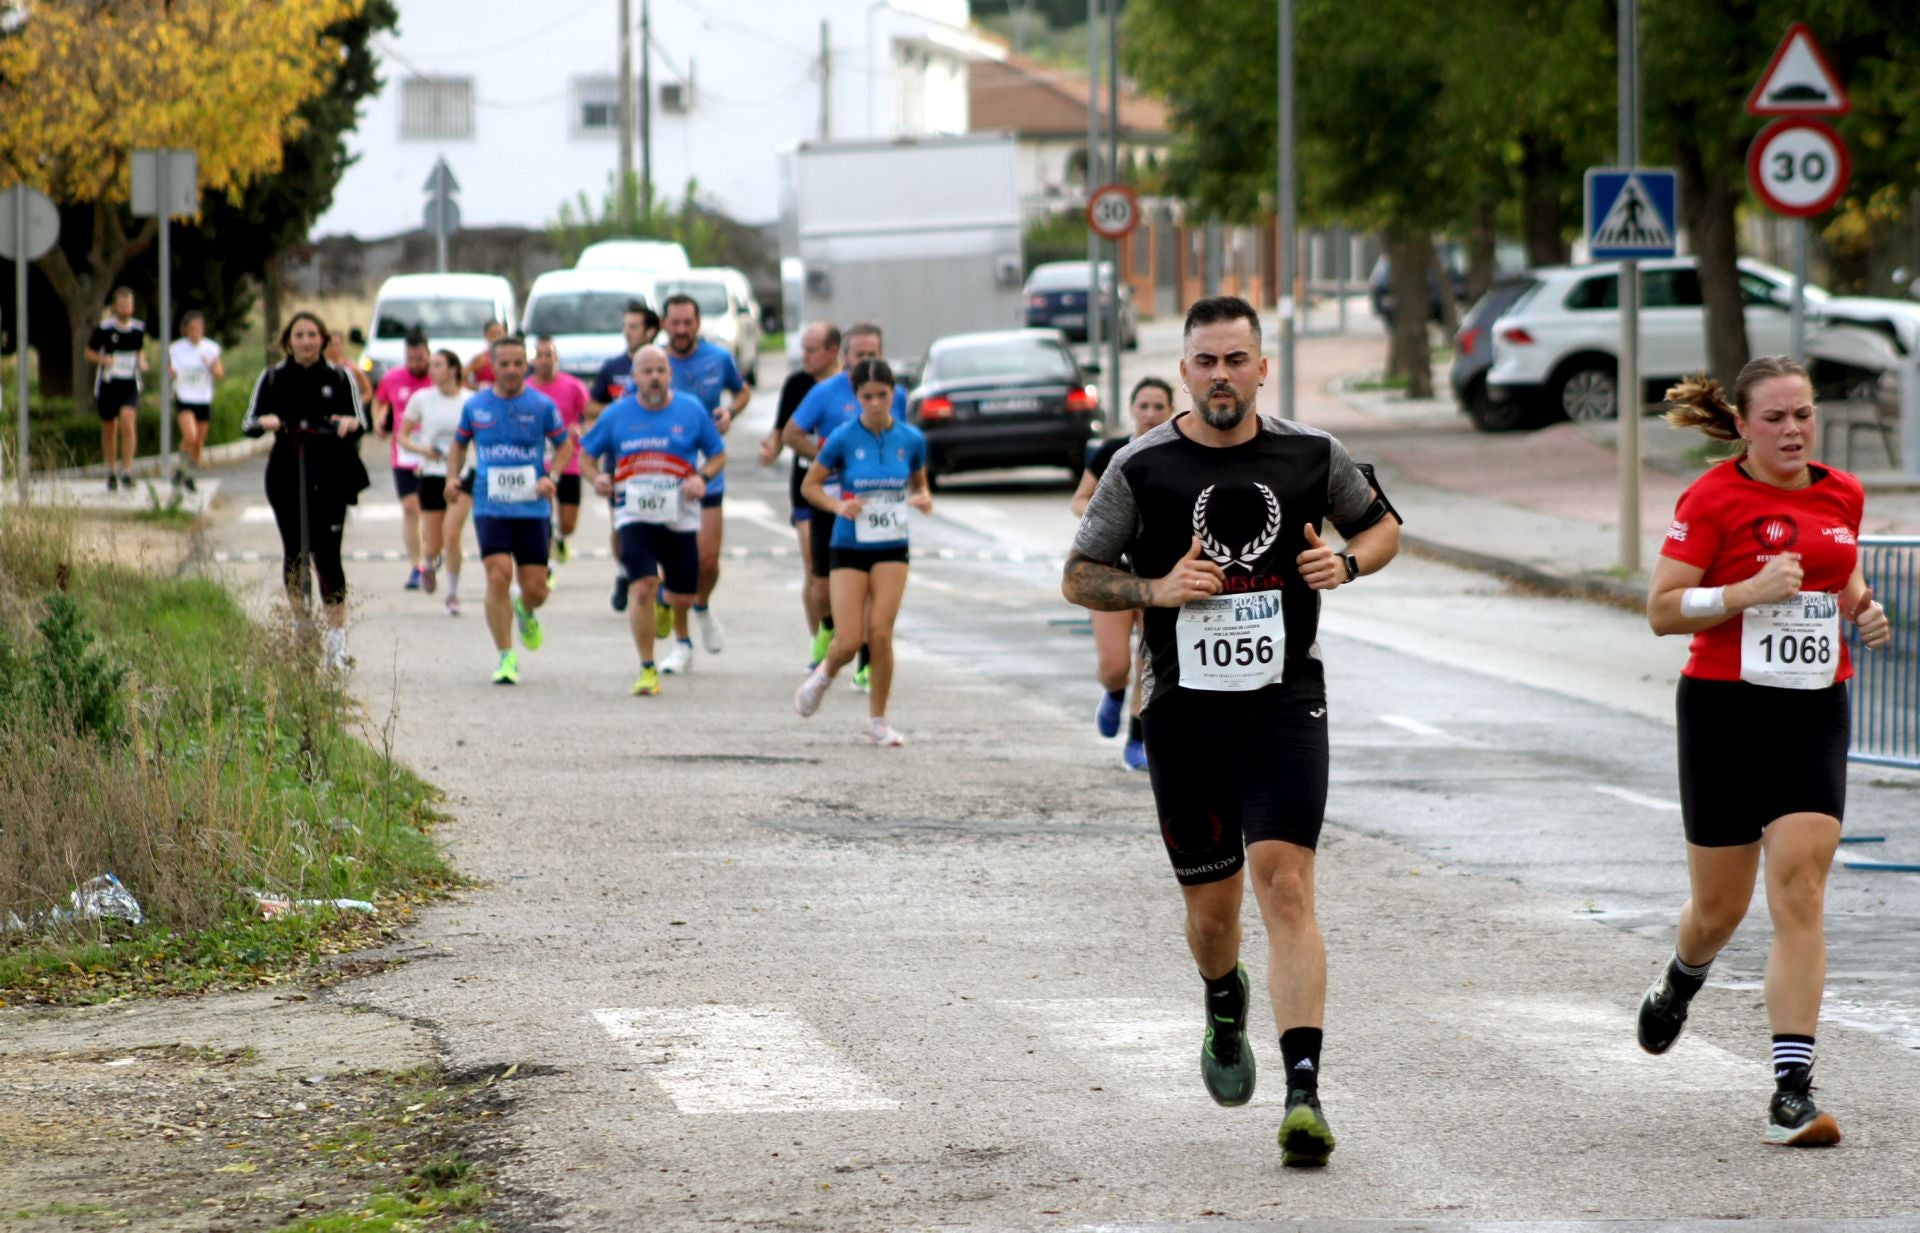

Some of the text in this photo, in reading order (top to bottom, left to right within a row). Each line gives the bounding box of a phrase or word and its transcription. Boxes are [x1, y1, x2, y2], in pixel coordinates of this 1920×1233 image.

[1772, 152, 1826, 183] 30
[1096, 199, 1129, 223] 30
[498, 473, 526, 487] 096
[638, 496, 666, 511] 967
[868, 512, 898, 528] 961
[1233, 596, 1260, 608] 2024
[1193, 635, 1273, 667] 1056
[1759, 634, 1830, 664] 1068
[1214, 855, 1237, 870] GYM
